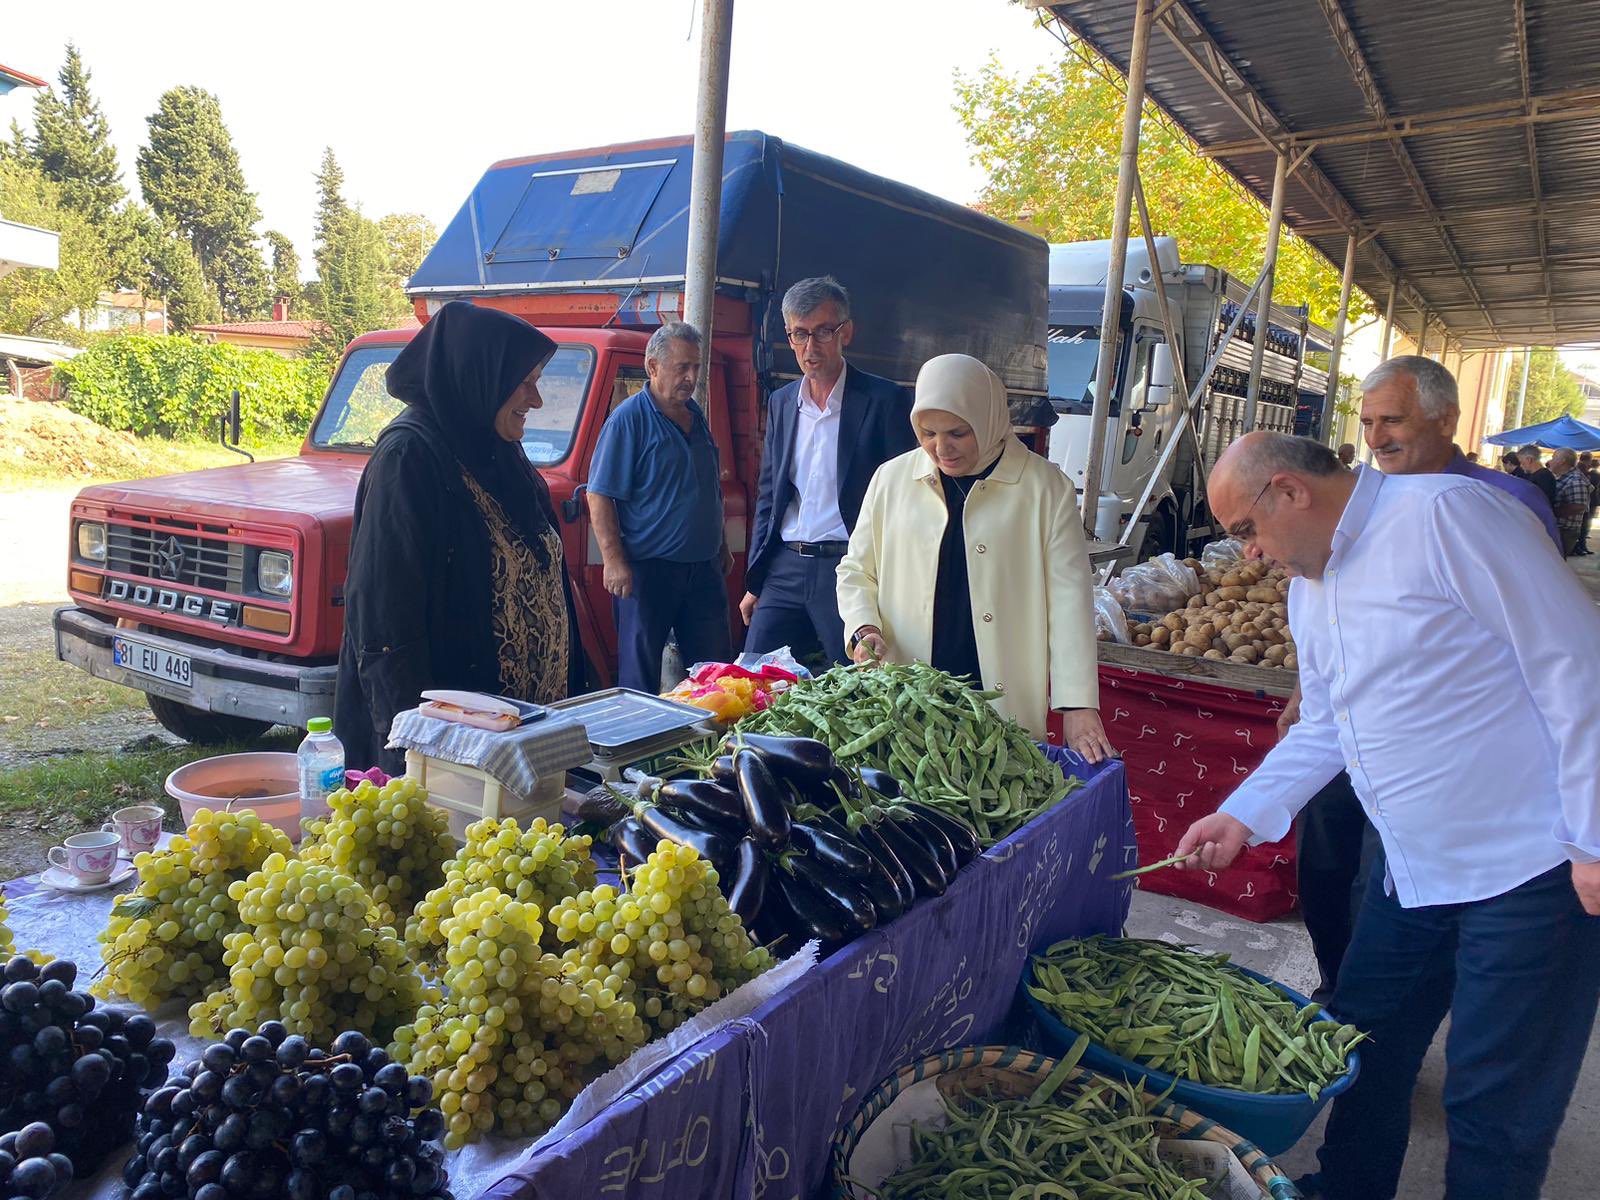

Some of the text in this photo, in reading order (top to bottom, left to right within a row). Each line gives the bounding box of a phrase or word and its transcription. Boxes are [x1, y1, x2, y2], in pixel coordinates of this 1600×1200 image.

[109, 580, 232, 624] DODGE
[121, 643, 189, 681] 81 EU 449
